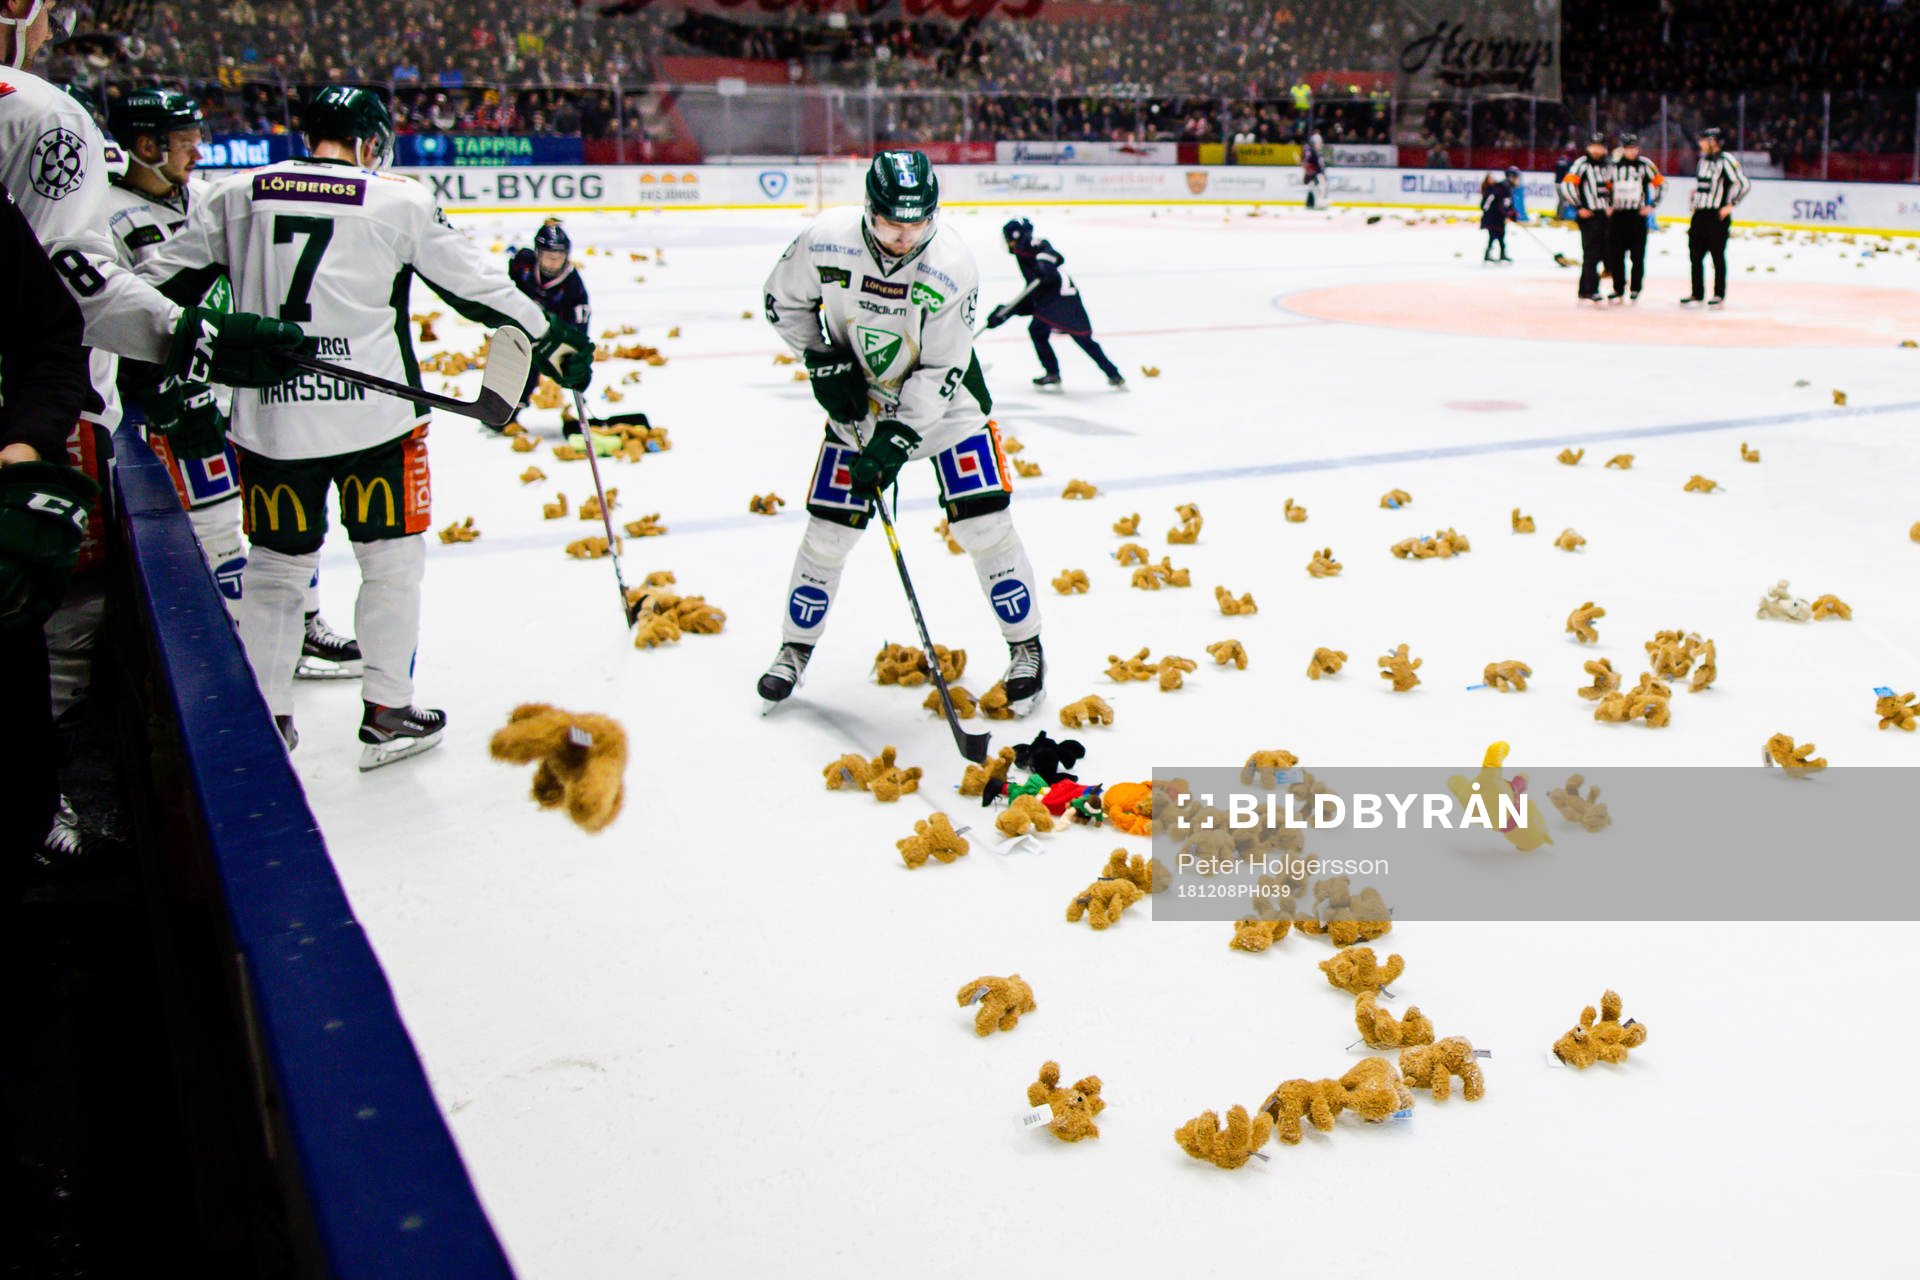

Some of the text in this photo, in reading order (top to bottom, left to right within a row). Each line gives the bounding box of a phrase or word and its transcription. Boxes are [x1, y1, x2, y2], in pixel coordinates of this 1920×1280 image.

[454, 137, 534, 155] TAPPRA
[261, 176, 357, 197] LÖFBERGS
[430, 174, 604, 200] XL-BYGG
[1792, 200, 1837, 220] STAR
[273, 214, 335, 322] 7
[858, 300, 908, 318] stadium
